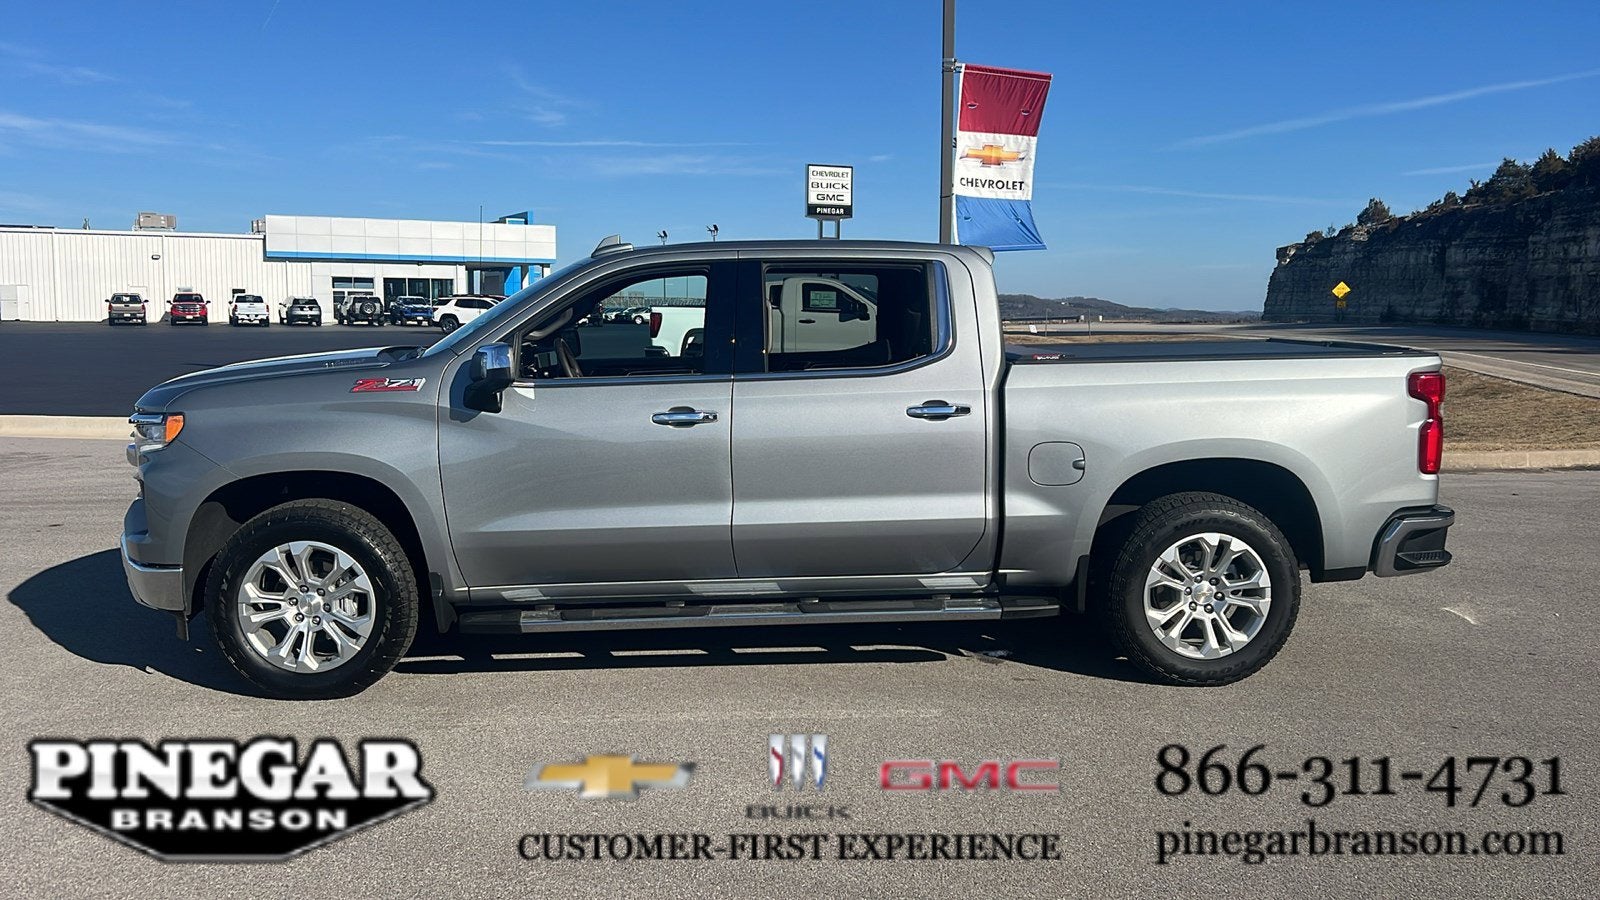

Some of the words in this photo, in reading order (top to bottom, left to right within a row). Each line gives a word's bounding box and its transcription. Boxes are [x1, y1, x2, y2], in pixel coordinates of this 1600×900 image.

[811, 170, 849, 178] CHEVROLET
[811, 181, 849, 190] BUICK
[959, 177, 1025, 191] CHEVROLET
[816, 193, 844, 201] GMC
[816, 207, 844, 215] PINEGAR
[351, 378, 426, 392] Z71
